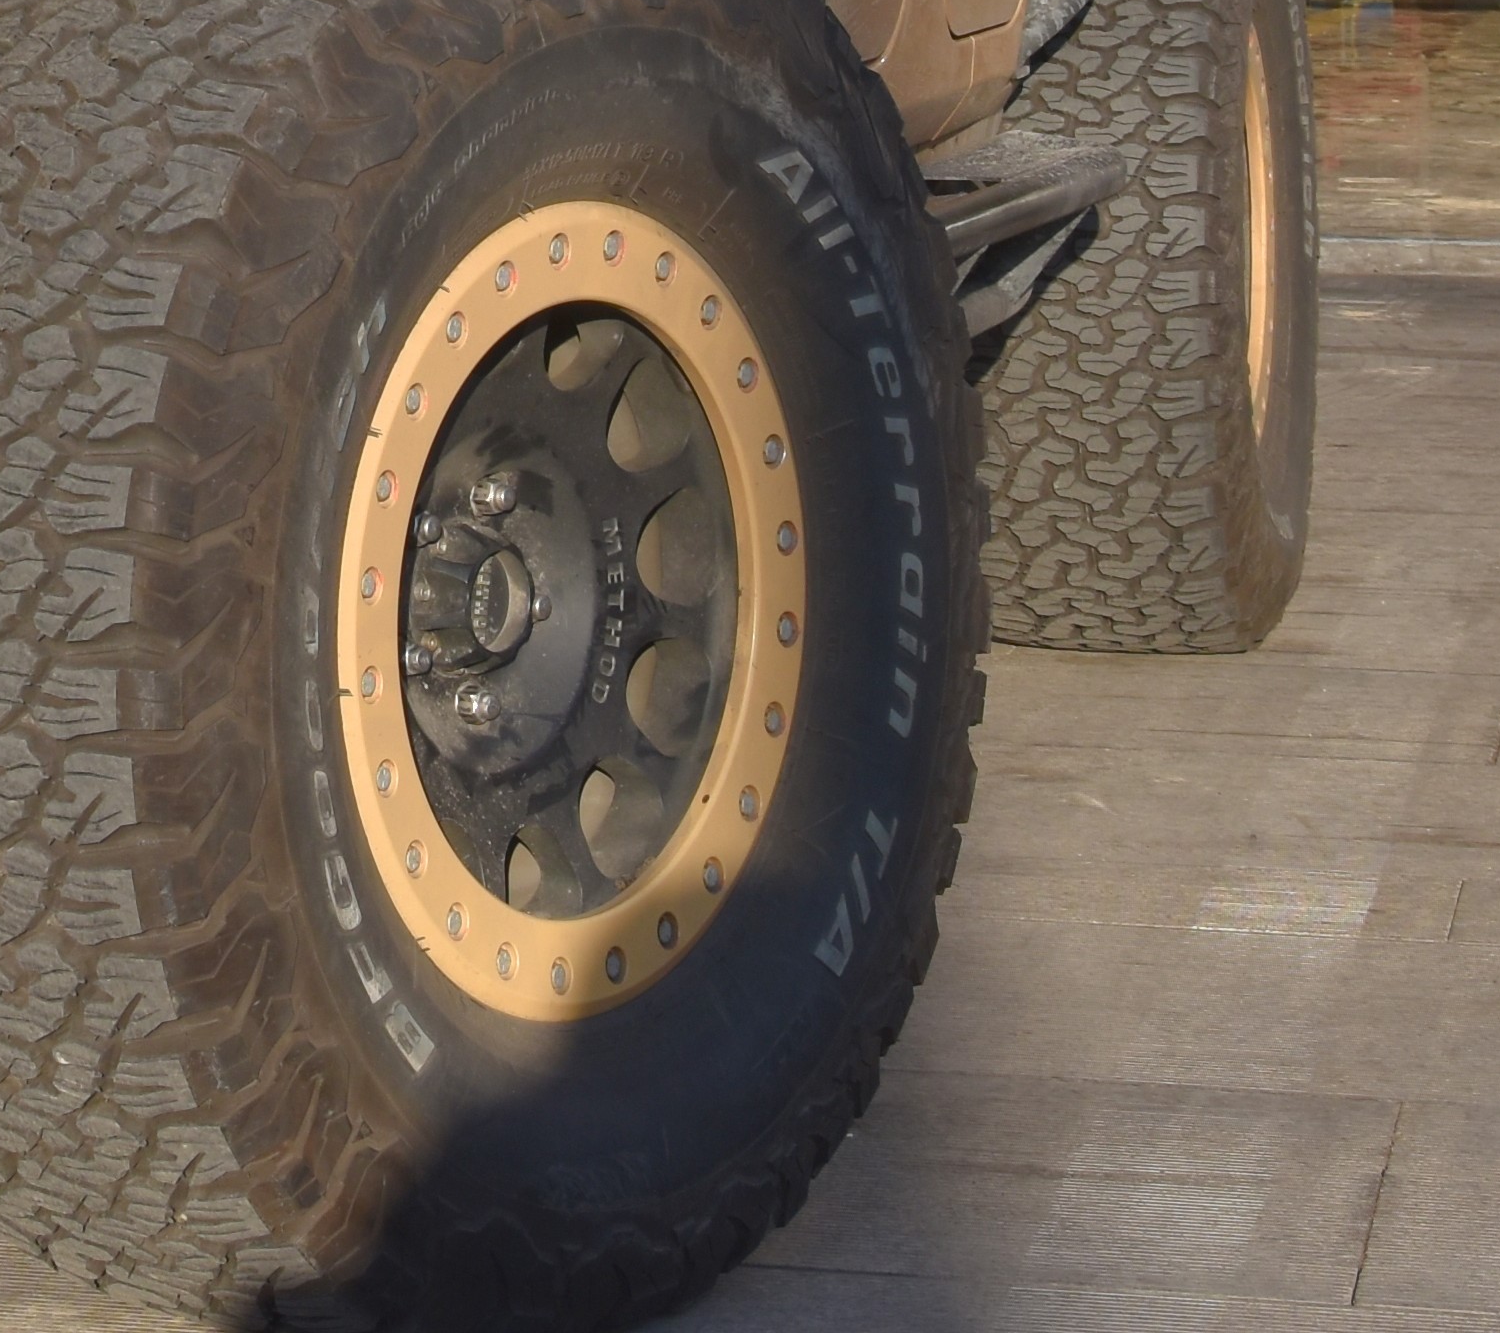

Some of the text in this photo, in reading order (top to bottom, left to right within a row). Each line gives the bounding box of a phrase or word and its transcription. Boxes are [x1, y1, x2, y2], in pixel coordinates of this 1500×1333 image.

[757, 147, 928, 739] All-Terrain
[591, 516, 624, 704] METHOD
[811, 807, 900, 978] T/A
